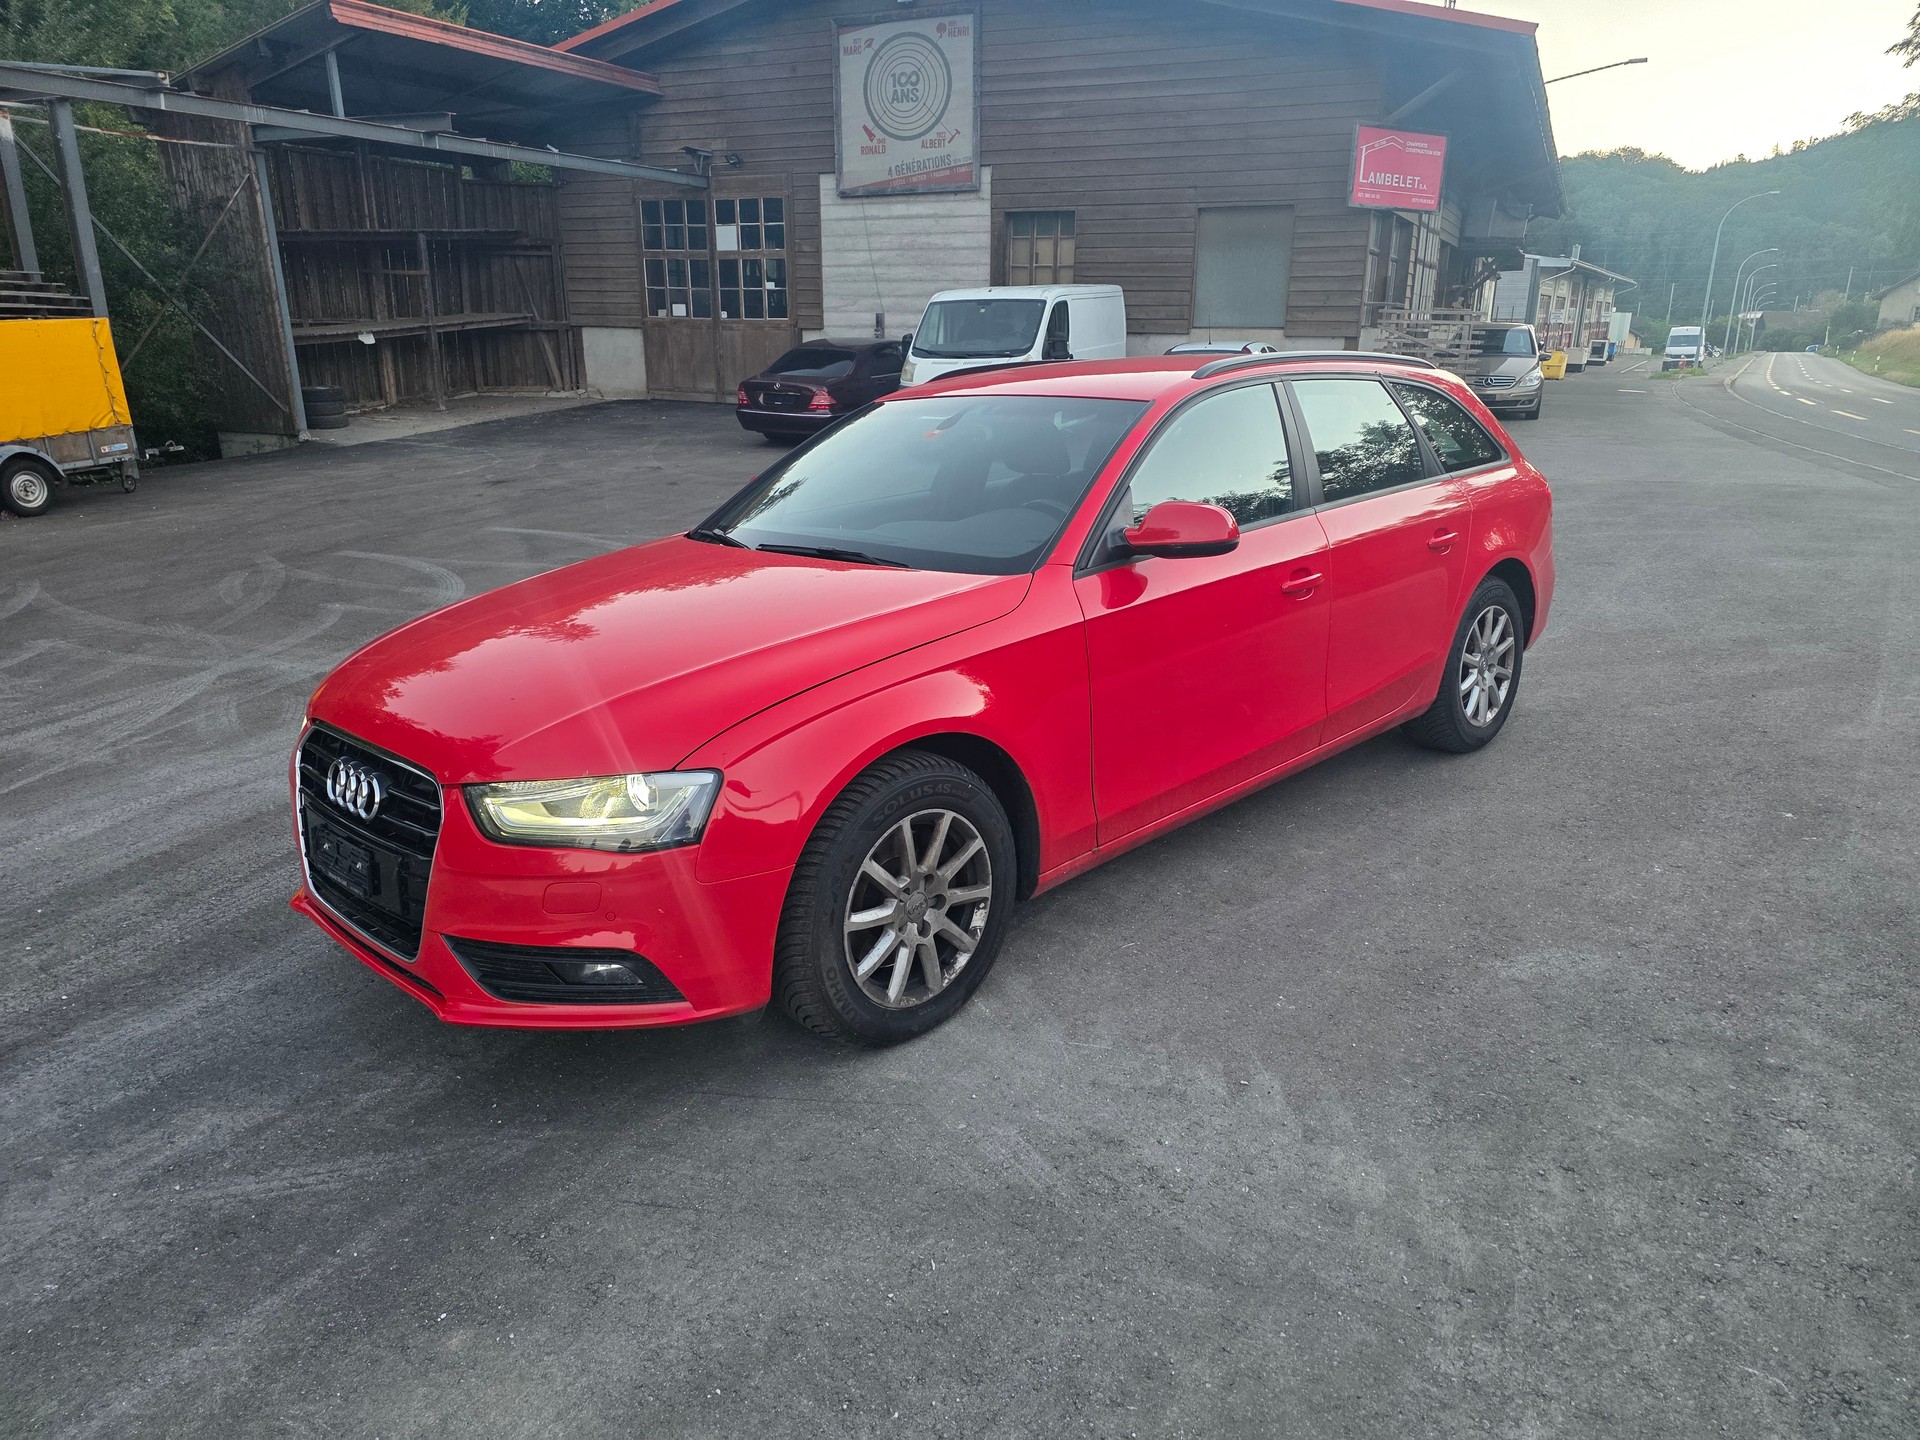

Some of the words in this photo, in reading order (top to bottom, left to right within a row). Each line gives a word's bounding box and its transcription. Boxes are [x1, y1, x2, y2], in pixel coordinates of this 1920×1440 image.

[948, 25, 969, 38] HENRI
[843, 45, 862, 56] MARC
[890, 70, 920, 88] 100
[890, 88, 919, 104] ANS
[860, 145, 886, 156] RONALD
[921, 138, 947, 149] ALBERT
[887, 166, 893, 178] 4
[895, 154, 951, 176] GÉNÉRATIONS
[872, 784, 934, 825] SOLUS
